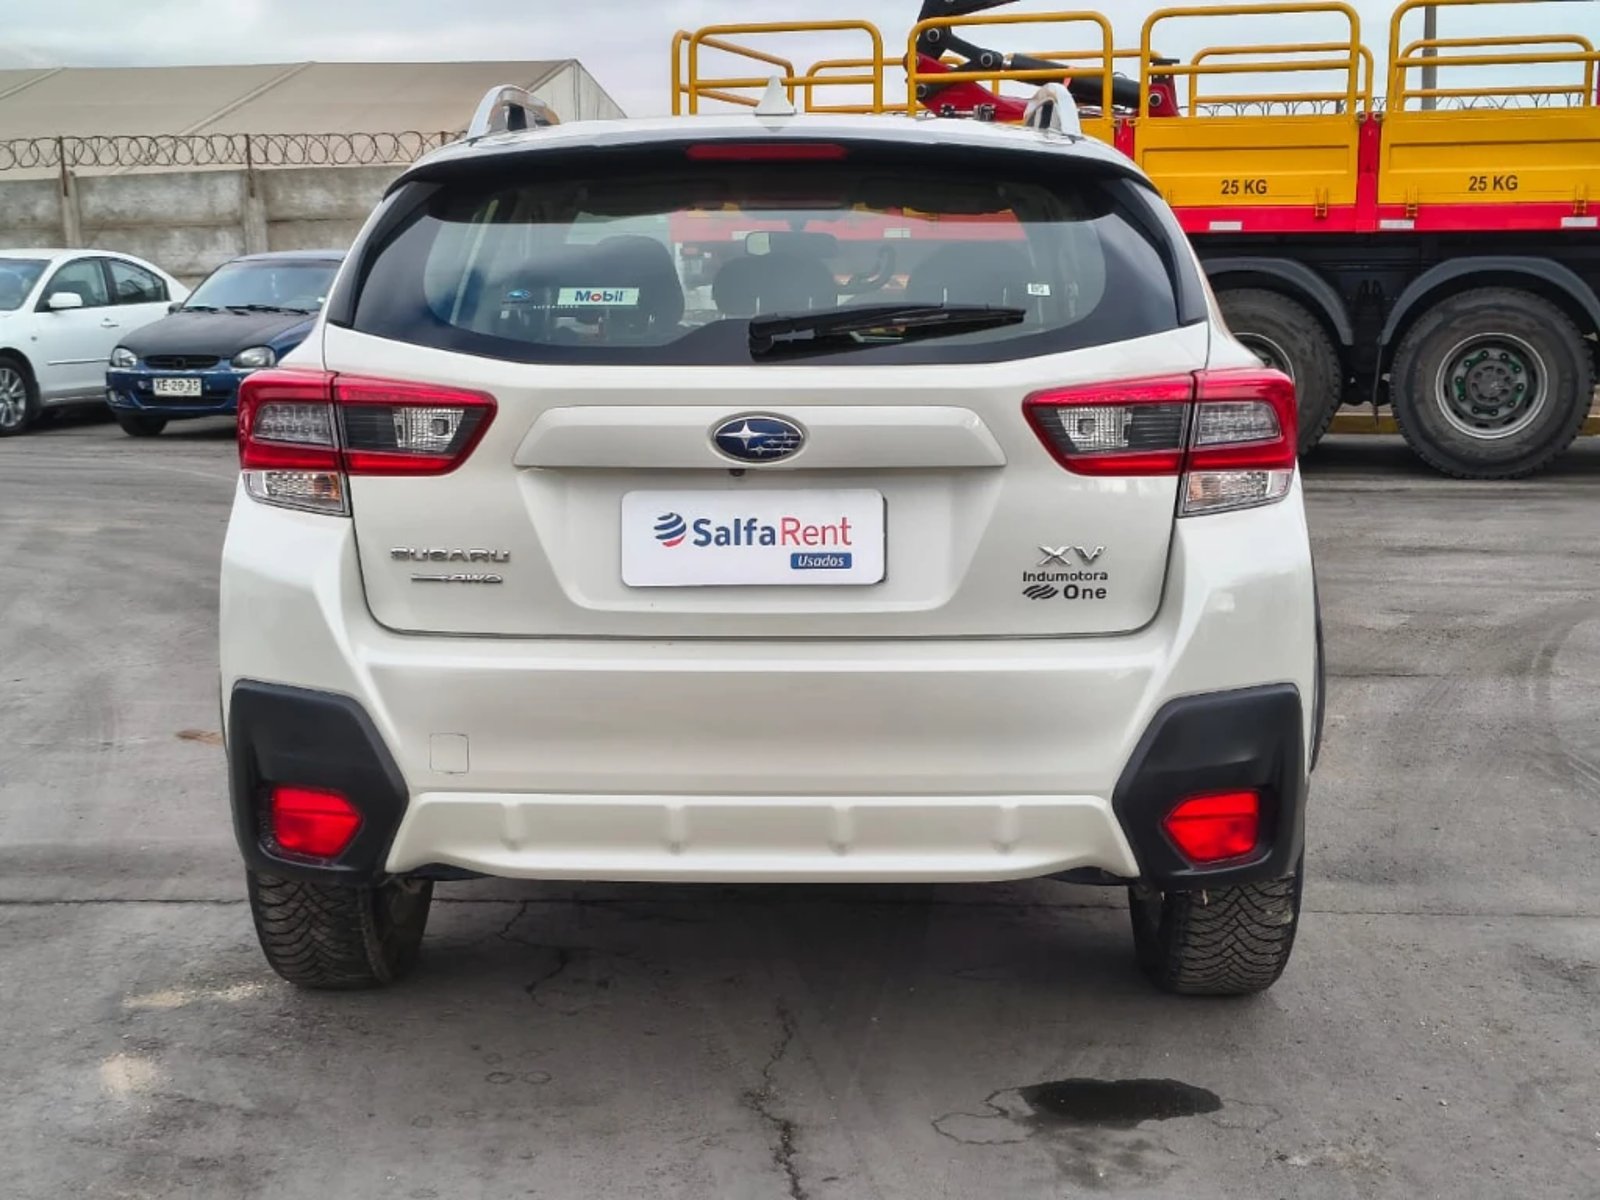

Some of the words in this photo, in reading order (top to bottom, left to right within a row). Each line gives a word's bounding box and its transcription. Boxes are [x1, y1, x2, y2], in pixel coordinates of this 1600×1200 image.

[1221, 180, 1238, 195] 25
[1244, 180, 1267, 195] KG
[1469, 177, 1486, 191] 25
[1492, 175, 1518, 191] KG
[575, 290, 623, 302] Mobil
[693, 517, 852, 547] SalfaRent
[390, 547, 510, 562] SUBARU
[798, 555, 844, 567] Usados
[1037, 546, 1106, 567] XV
[1022, 571, 1108, 582] Indumotora
[1063, 584, 1107, 600] One
